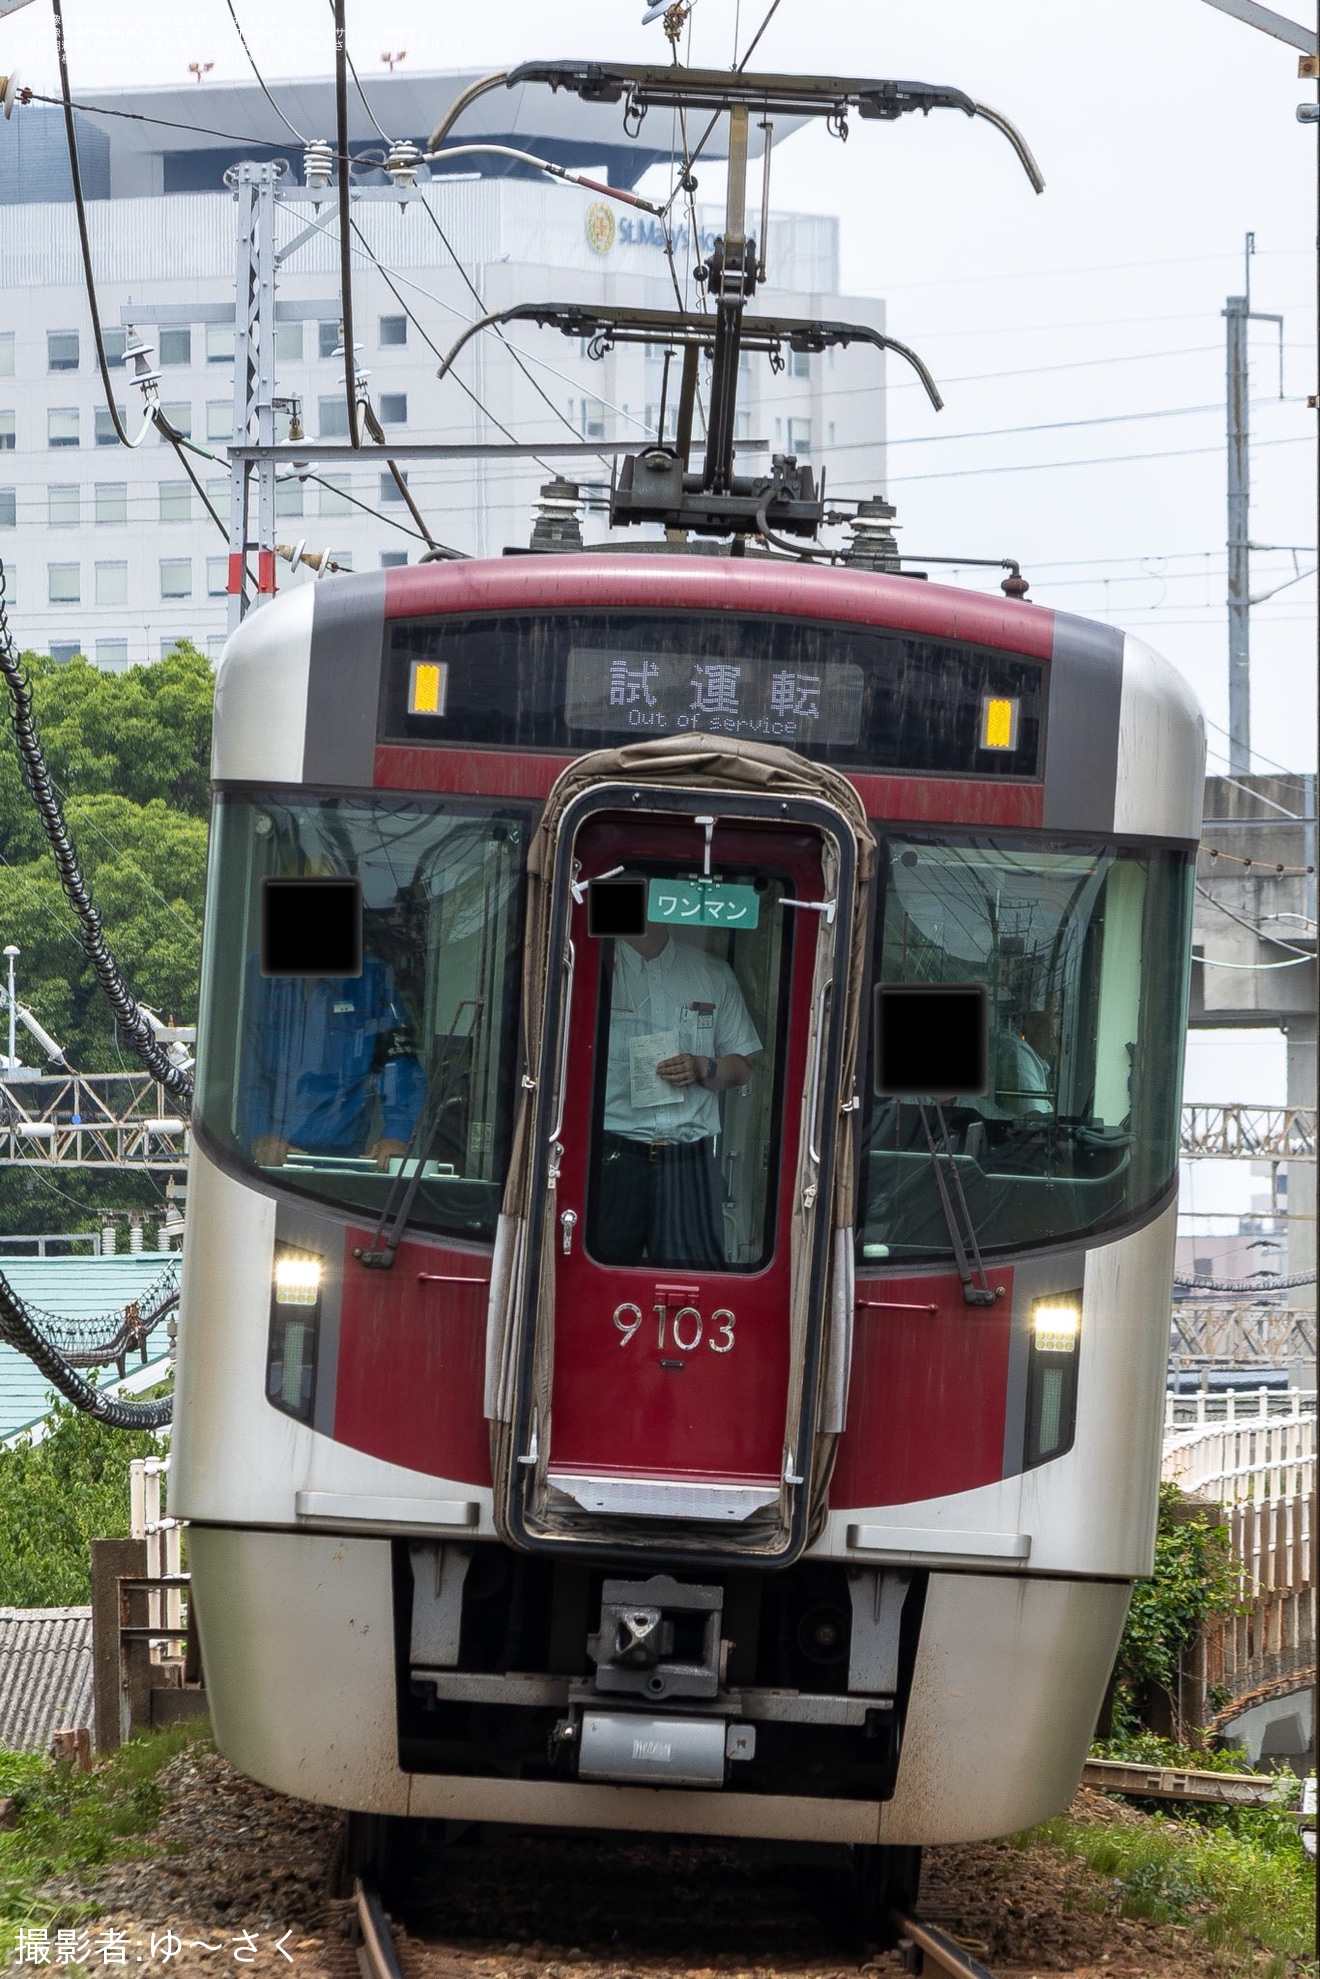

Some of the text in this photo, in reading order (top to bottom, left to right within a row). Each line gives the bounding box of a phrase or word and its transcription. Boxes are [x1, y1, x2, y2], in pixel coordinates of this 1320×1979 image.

[610, 660, 821, 719] 試運転
[628, 709, 797, 735] Out of service
[658, 896, 748, 920] ワンマン
[613, 1302, 736, 1353] 9103
